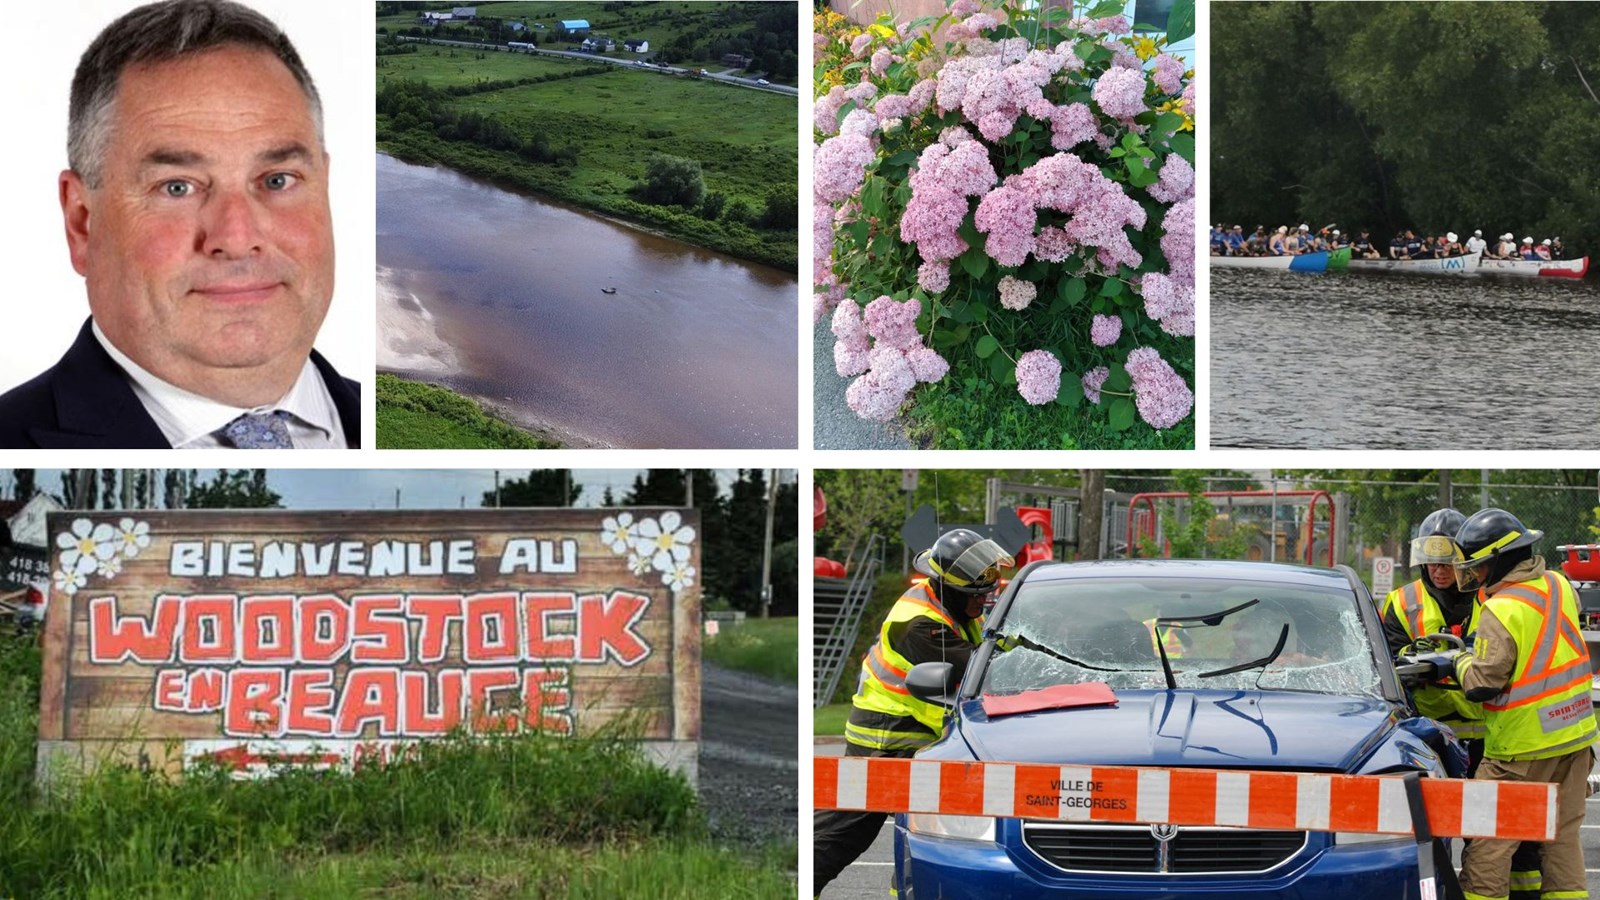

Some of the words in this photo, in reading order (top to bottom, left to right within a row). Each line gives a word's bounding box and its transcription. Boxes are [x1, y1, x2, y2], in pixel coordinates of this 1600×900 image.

[170, 540, 476, 578] BIENVENUE
[499, 538, 578, 574] AU
[89, 590, 652, 667] WOODSTOCK
[155, 668, 226, 712] EN
[225, 667, 573, 738] BEAUCE
[1025, 794, 1127, 811] SAINT-GEORGES
[1050, 780, 1084, 792] VILLE
[1086, 781, 1104, 793] DE
